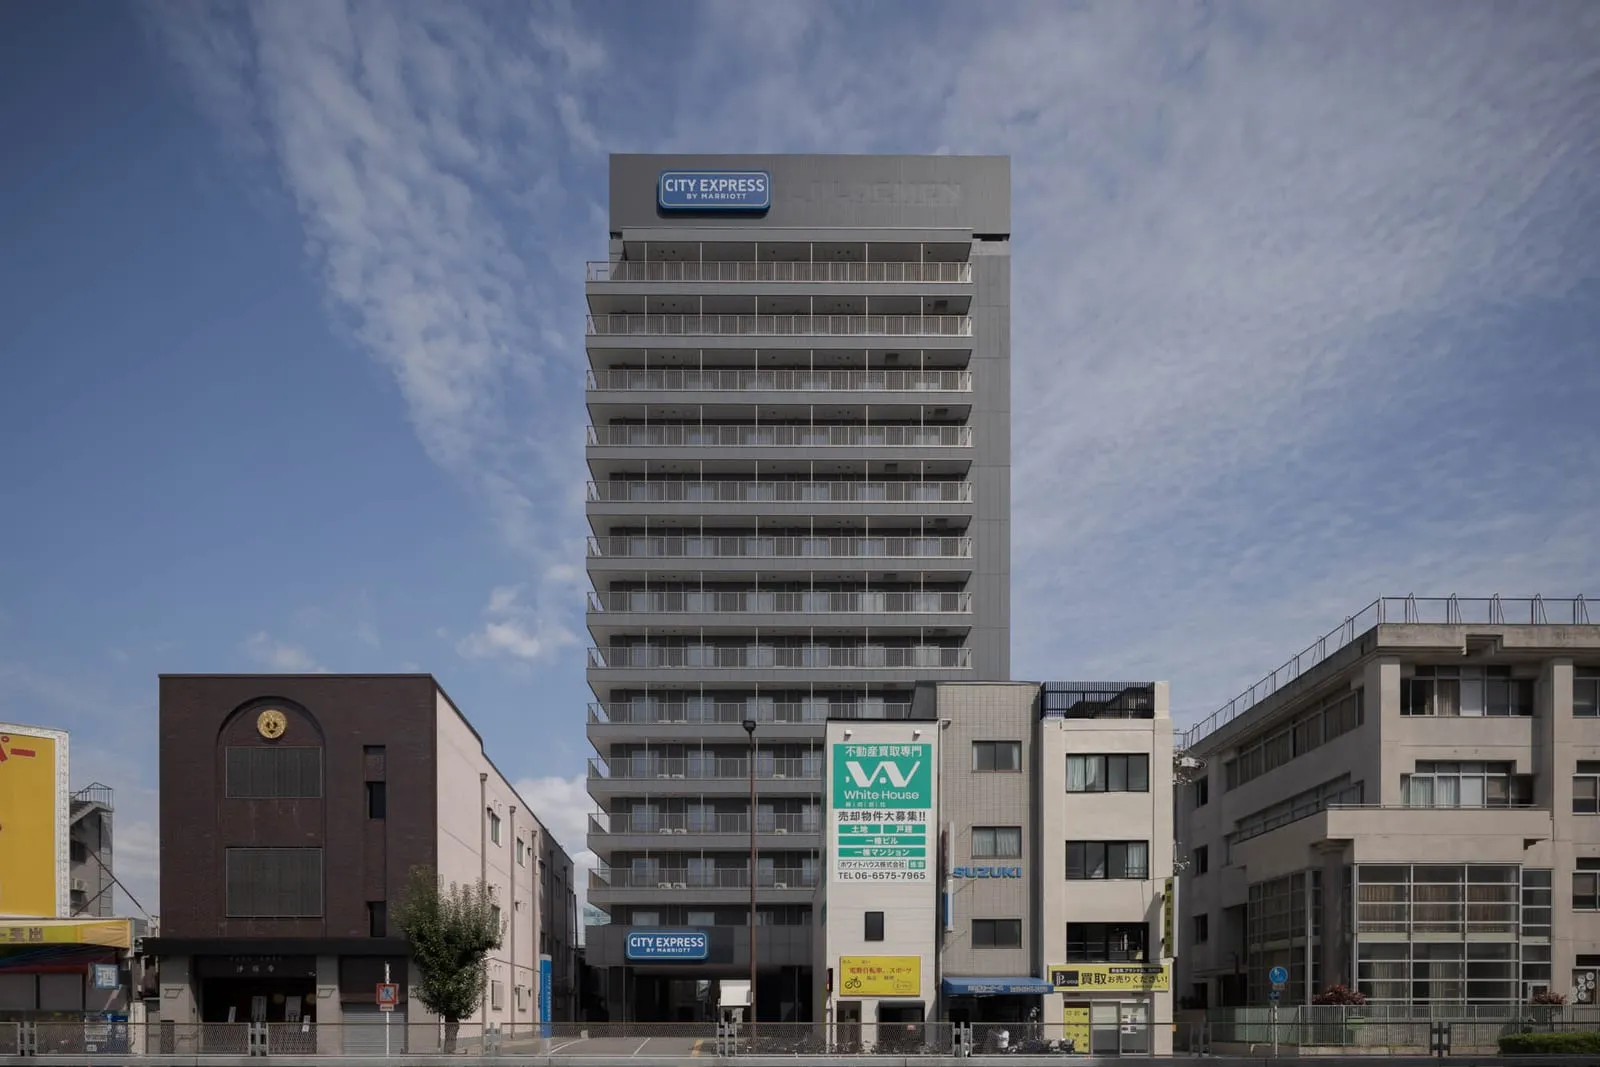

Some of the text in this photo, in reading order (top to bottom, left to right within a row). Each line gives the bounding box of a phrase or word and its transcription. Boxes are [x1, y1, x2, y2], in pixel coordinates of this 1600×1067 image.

[665, 179, 696, 192] CITY
[700, 179, 765, 192] EXPRESS
[845, 746, 922, 757] 不動産買取専門
[844, 790, 920, 800] White House
[851, 825, 869, 834] 土地
[840, 861, 905, 869] ホワイトハウス株式会社
[952, 866, 1023, 878] SUZUKI
[631, 937, 704, 947] CITY EXPRESS
